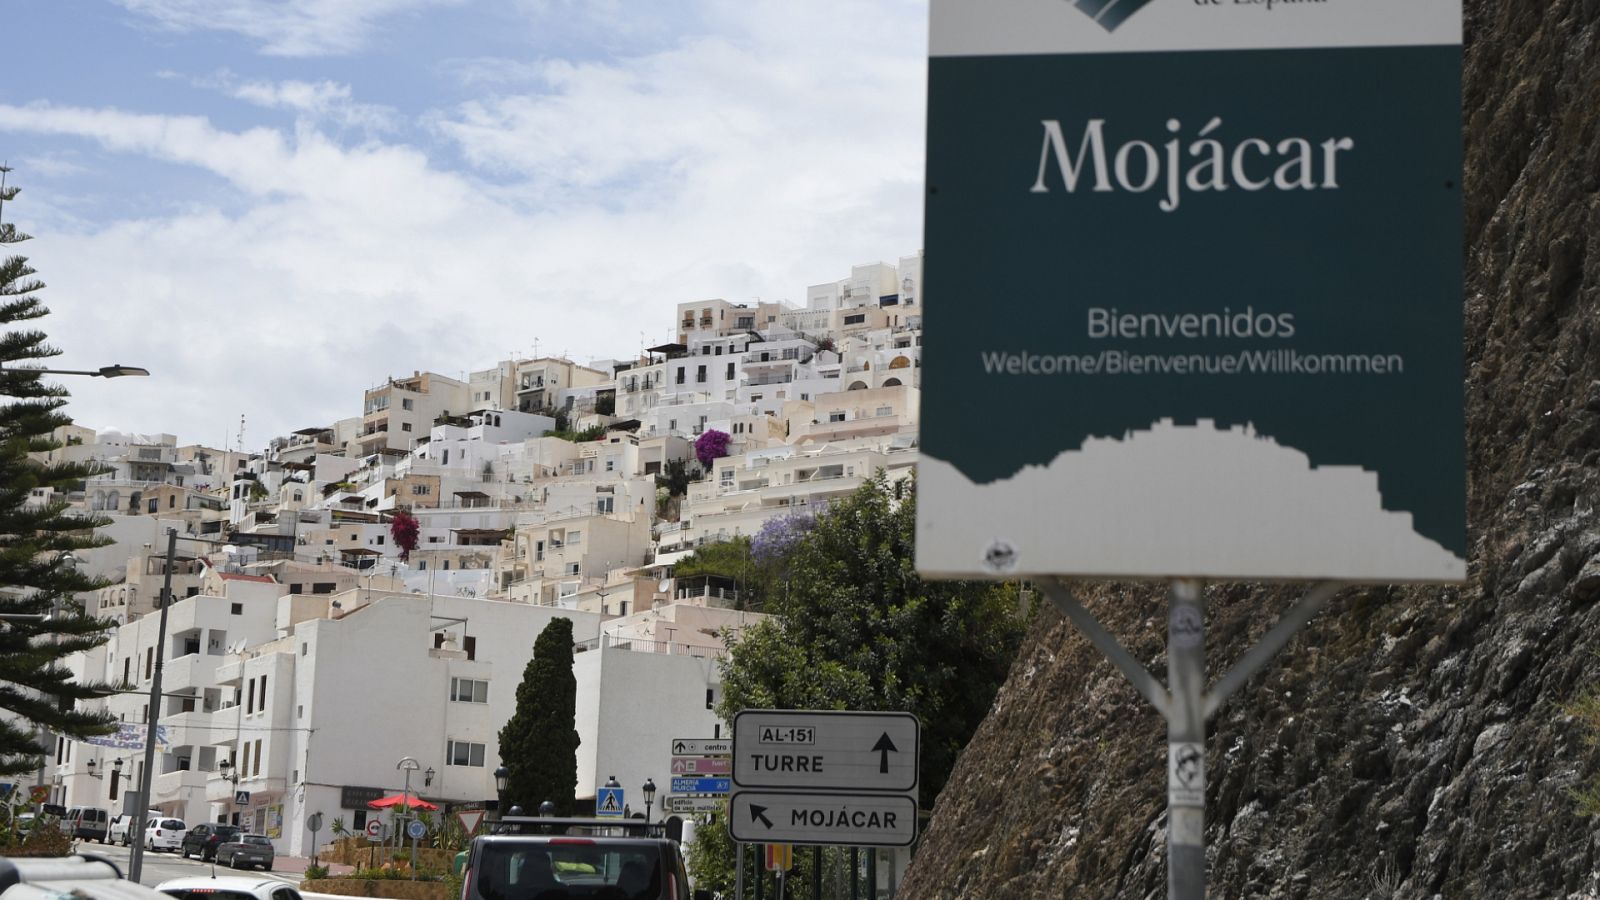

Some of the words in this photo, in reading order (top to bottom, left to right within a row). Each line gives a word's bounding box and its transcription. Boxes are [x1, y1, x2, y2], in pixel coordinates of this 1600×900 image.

[1029, 116, 1354, 212] Mojácar
[1087, 305, 1296, 339] Bienvenidos
[981, 349, 1404, 376] Welcome/Bienvenue/Willkommen
[762, 728, 813, 742] AL-151
[751, 754, 824, 772] TURRE
[791, 804, 897, 829] MOJÁCAR
